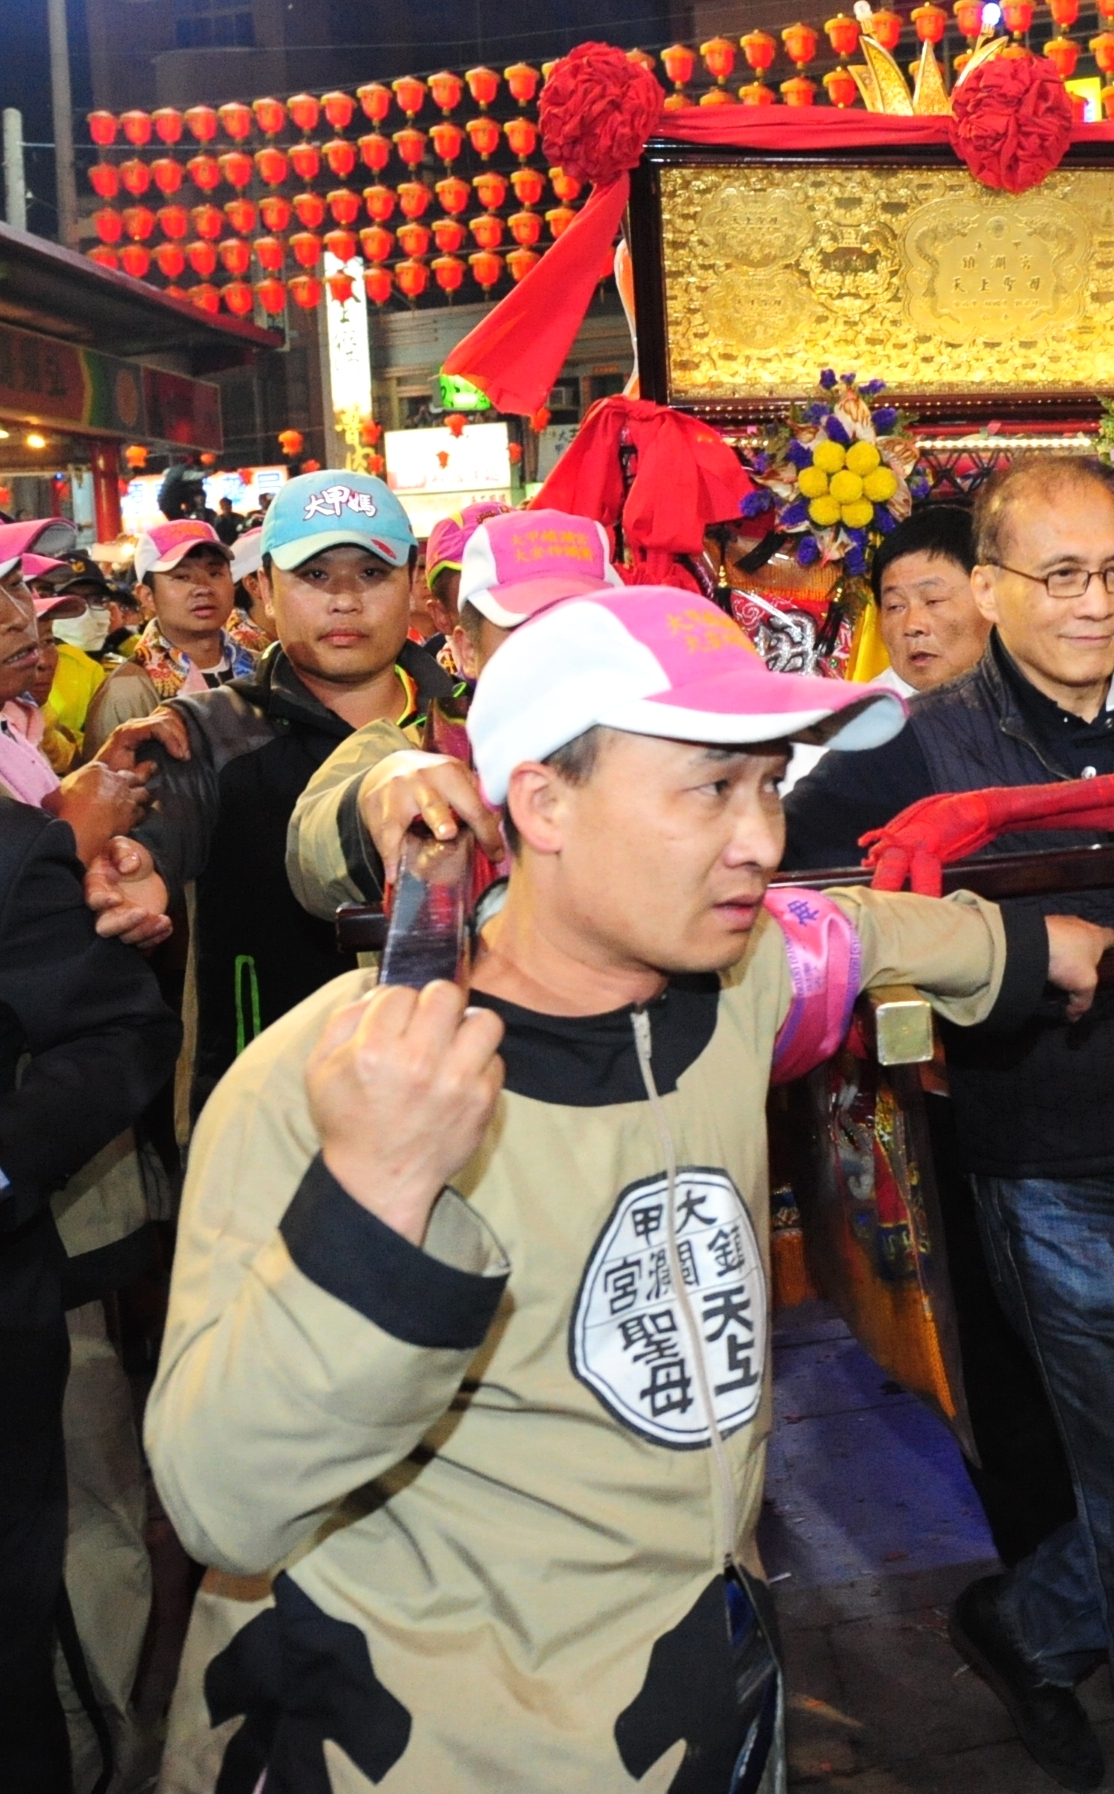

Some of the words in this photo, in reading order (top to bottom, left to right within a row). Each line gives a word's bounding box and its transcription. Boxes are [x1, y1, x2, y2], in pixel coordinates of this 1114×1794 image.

[951, 275, 1043, 293] 天上聖母
[302, 484, 378, 521] 大甲媽
